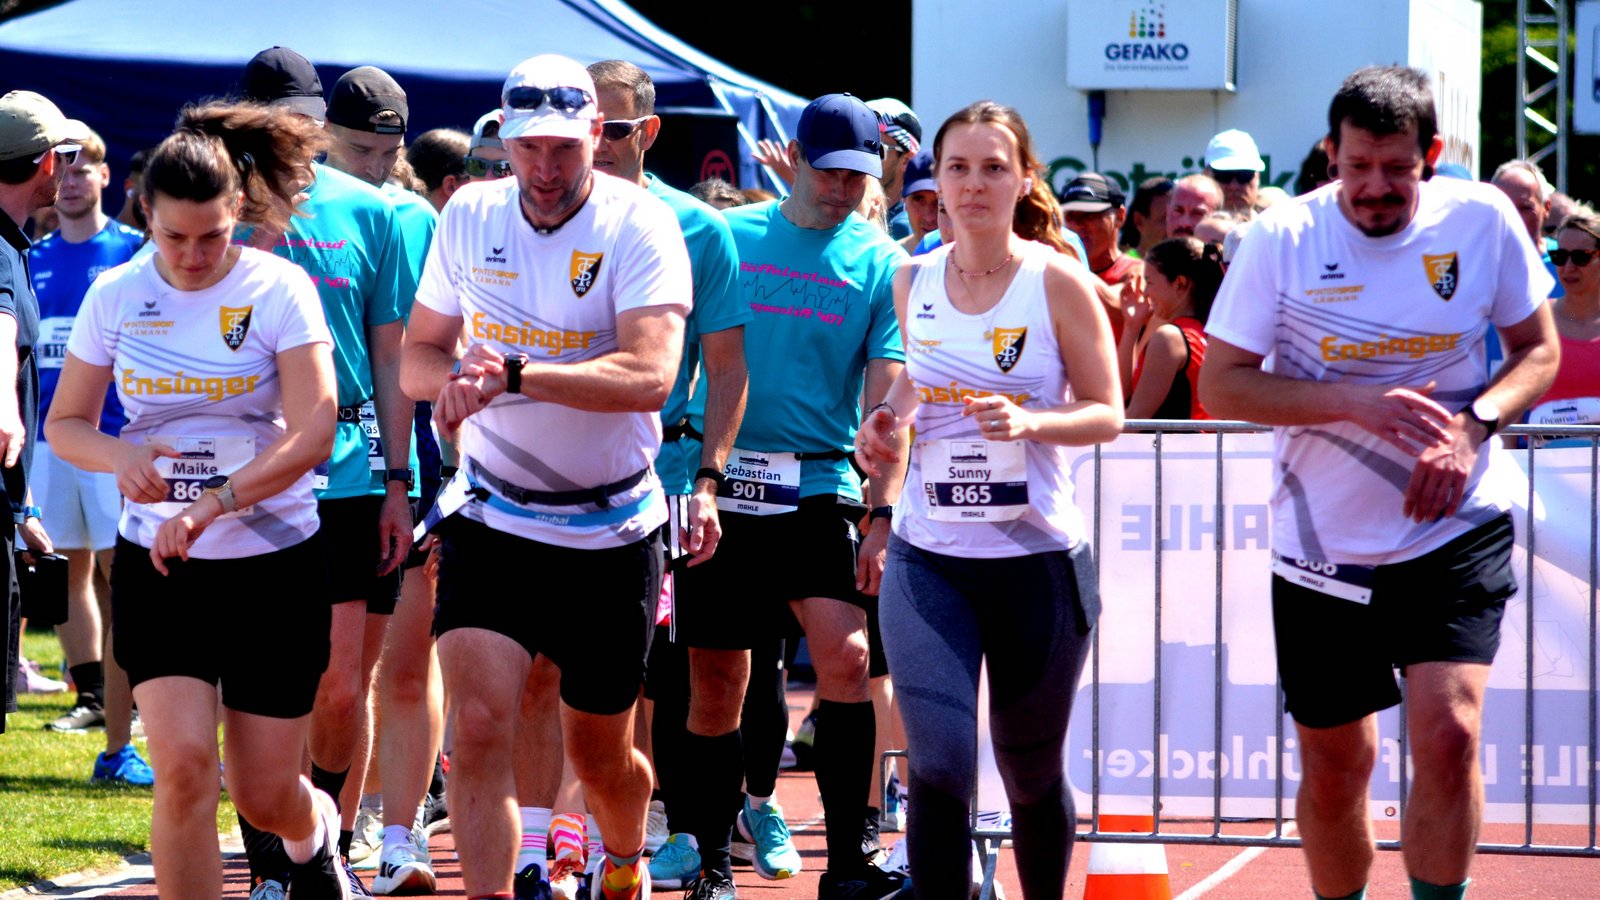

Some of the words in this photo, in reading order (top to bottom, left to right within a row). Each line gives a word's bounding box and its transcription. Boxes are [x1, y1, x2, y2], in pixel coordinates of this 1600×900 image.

[1104, 43, 1189, 61] GEFAKO
[472, 311, 597, 356] Ensinger
[1320, 332, 1462, 362] Ensinger
[122, 369, 260, 401] Ensinger
[172, 462, 218, 475] Maike
[724, 464, 781, 481] Sebastian
[948, 466, 991, 481] Sunny
[173, 481, 202, 500] 86
[732, 481, 765, 500] 901
[951, 485, 992, 504] 865
